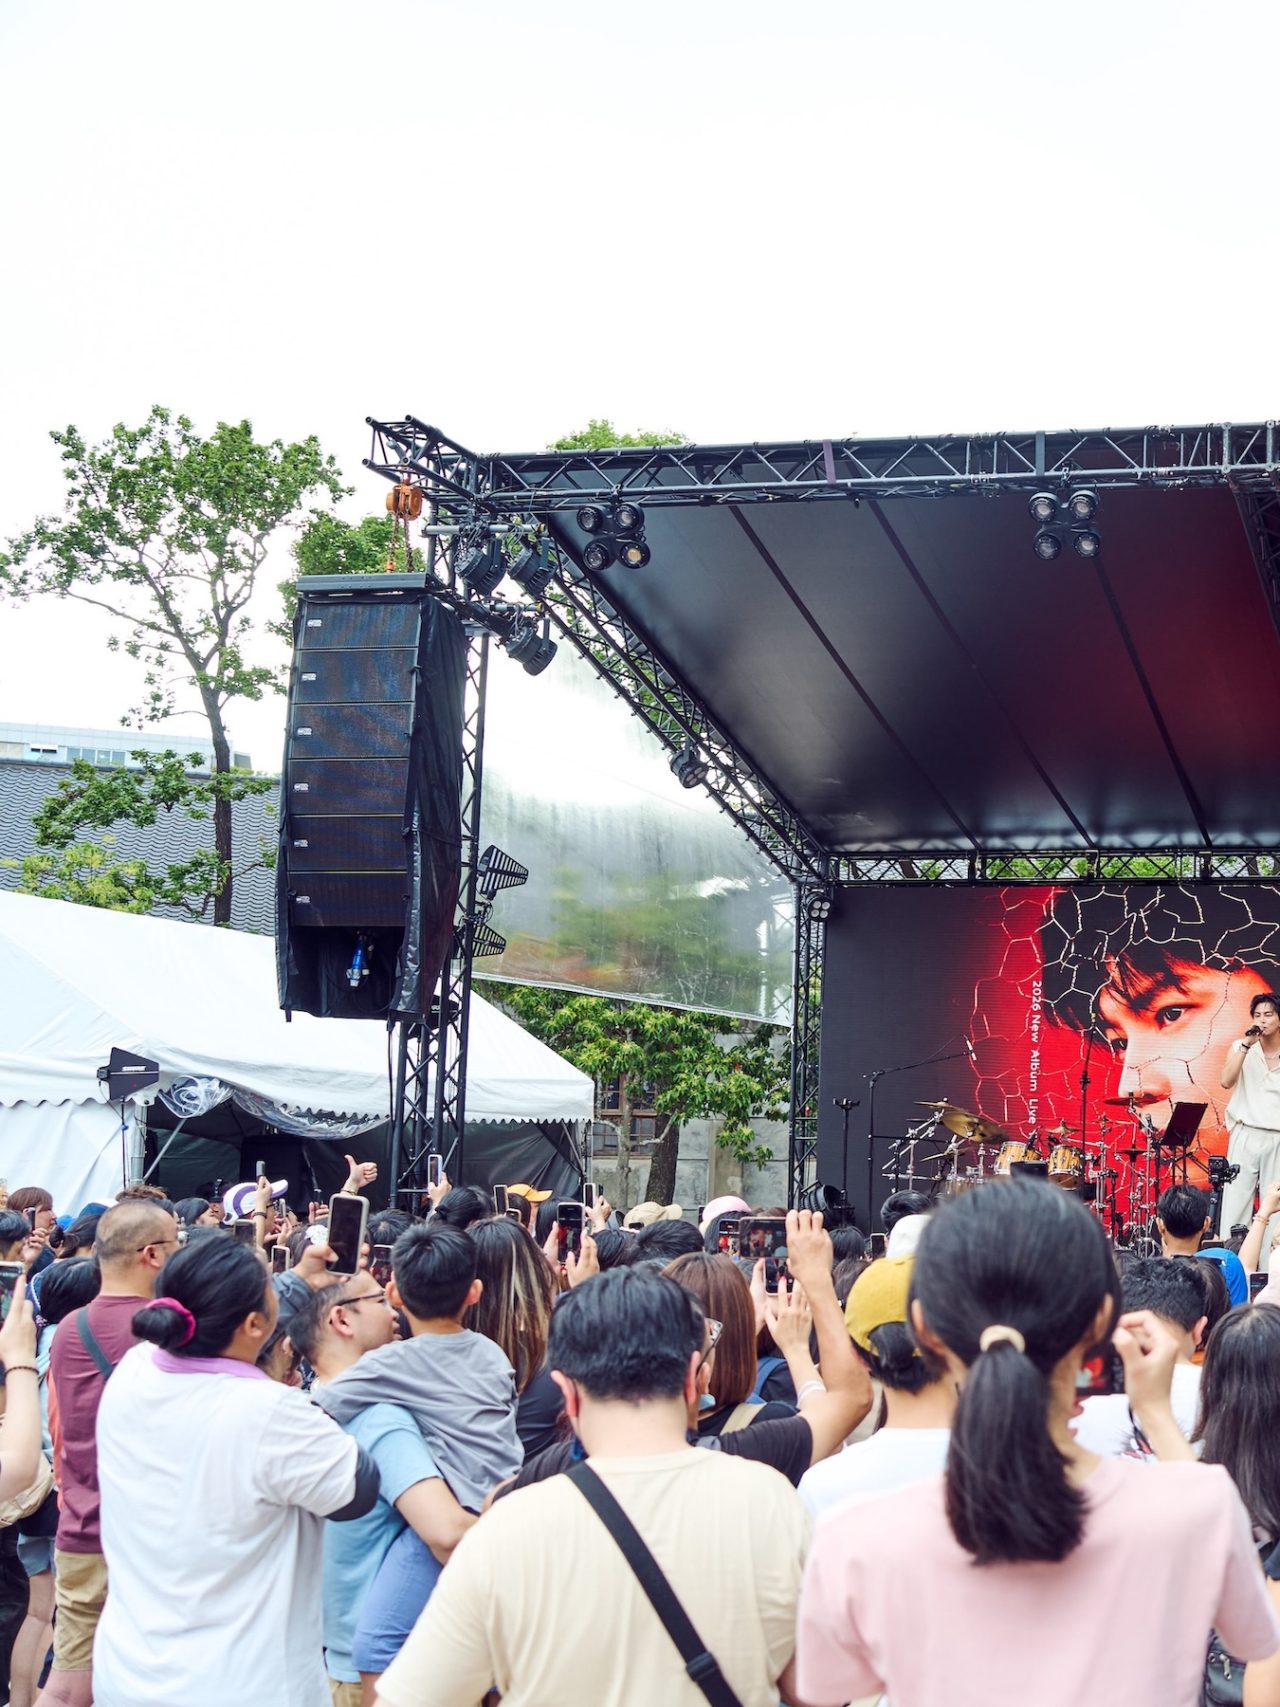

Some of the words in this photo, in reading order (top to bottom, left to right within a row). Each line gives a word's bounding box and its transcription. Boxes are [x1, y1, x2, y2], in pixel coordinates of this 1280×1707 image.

[1032, 981, 1042, 1011] 2026
[1031, 1014, 1041, 1043] New
[1030, 1049, 1041, 1092] Album
[1028, 1098, 1039, 1124] Live
